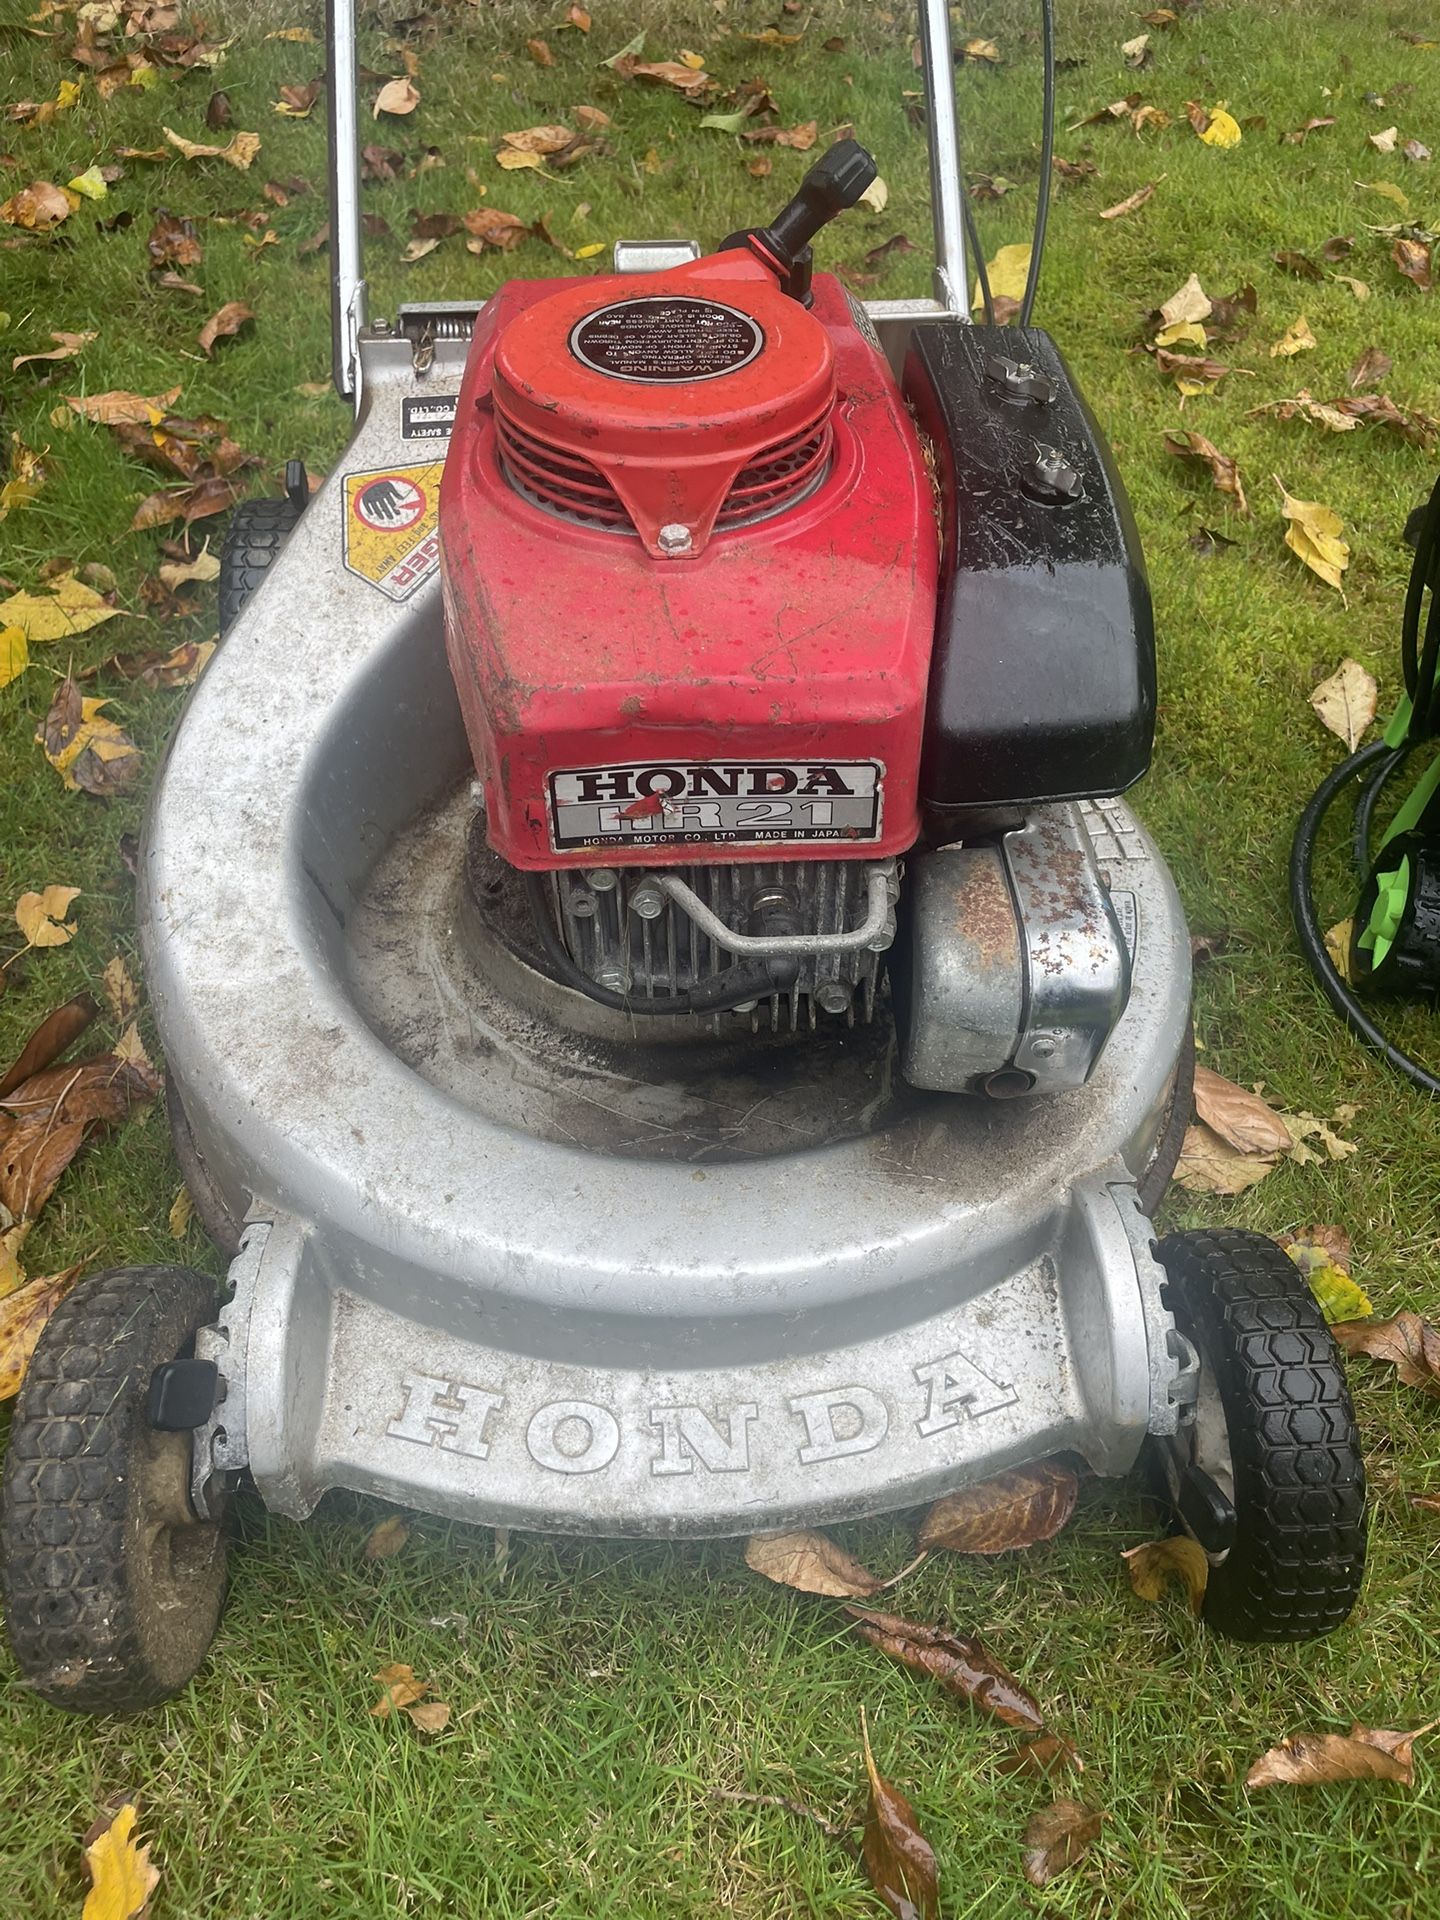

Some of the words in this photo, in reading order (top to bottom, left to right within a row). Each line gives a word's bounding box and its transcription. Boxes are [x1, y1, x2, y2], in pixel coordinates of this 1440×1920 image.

[411, 428, 441, 437] SAFETY
[396, 536, 415, 555] FEET
[376, 554, 396, 574] AWAY
[391, 538, 440, 586] GER
[576, 768, 854, 801] HONDA
[634, 834, 675, 843] MOTOR
[755, 830, 787, 839] MADE
[794, 830, 805, 838] IN
[812, 829, 841, 838] JAPA
[385, 1351, 1020, 1477] HONDA
